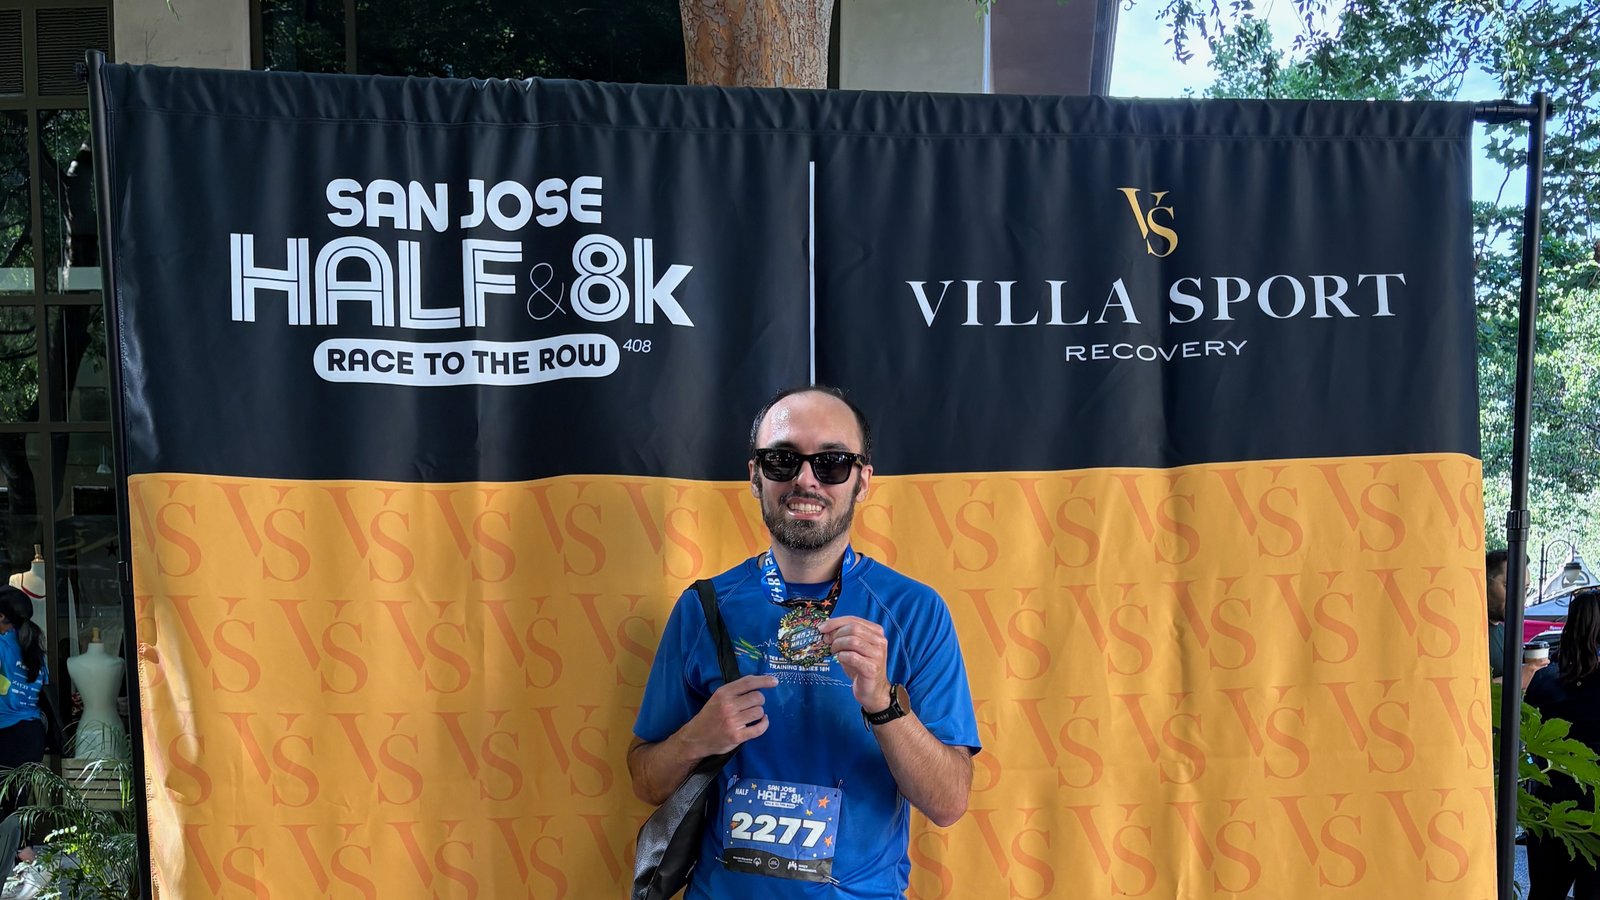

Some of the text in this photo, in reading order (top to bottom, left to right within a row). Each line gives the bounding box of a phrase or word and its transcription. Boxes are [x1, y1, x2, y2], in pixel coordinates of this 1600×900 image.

[326, 175, 602, 233] SAN JOSE
[230, 233, 522, 330] HALF
[527, 262, 567, 320] &
[906, 272, 1406, 328] VILLA SPORT
[622, 338, 652, 353] 408
[1065, 340, 1247, 362] RECOVERY
[327, 343, 606, 376] RACE TO THE ROW
[769, 663, 797, 671] TRAINING
[735, 788, 749, 796] HALF
[757, 789, 786, 802] HALF
[767, 784, 796, 793] SAN JOSE
[731, 811, 827, 848] 2277
